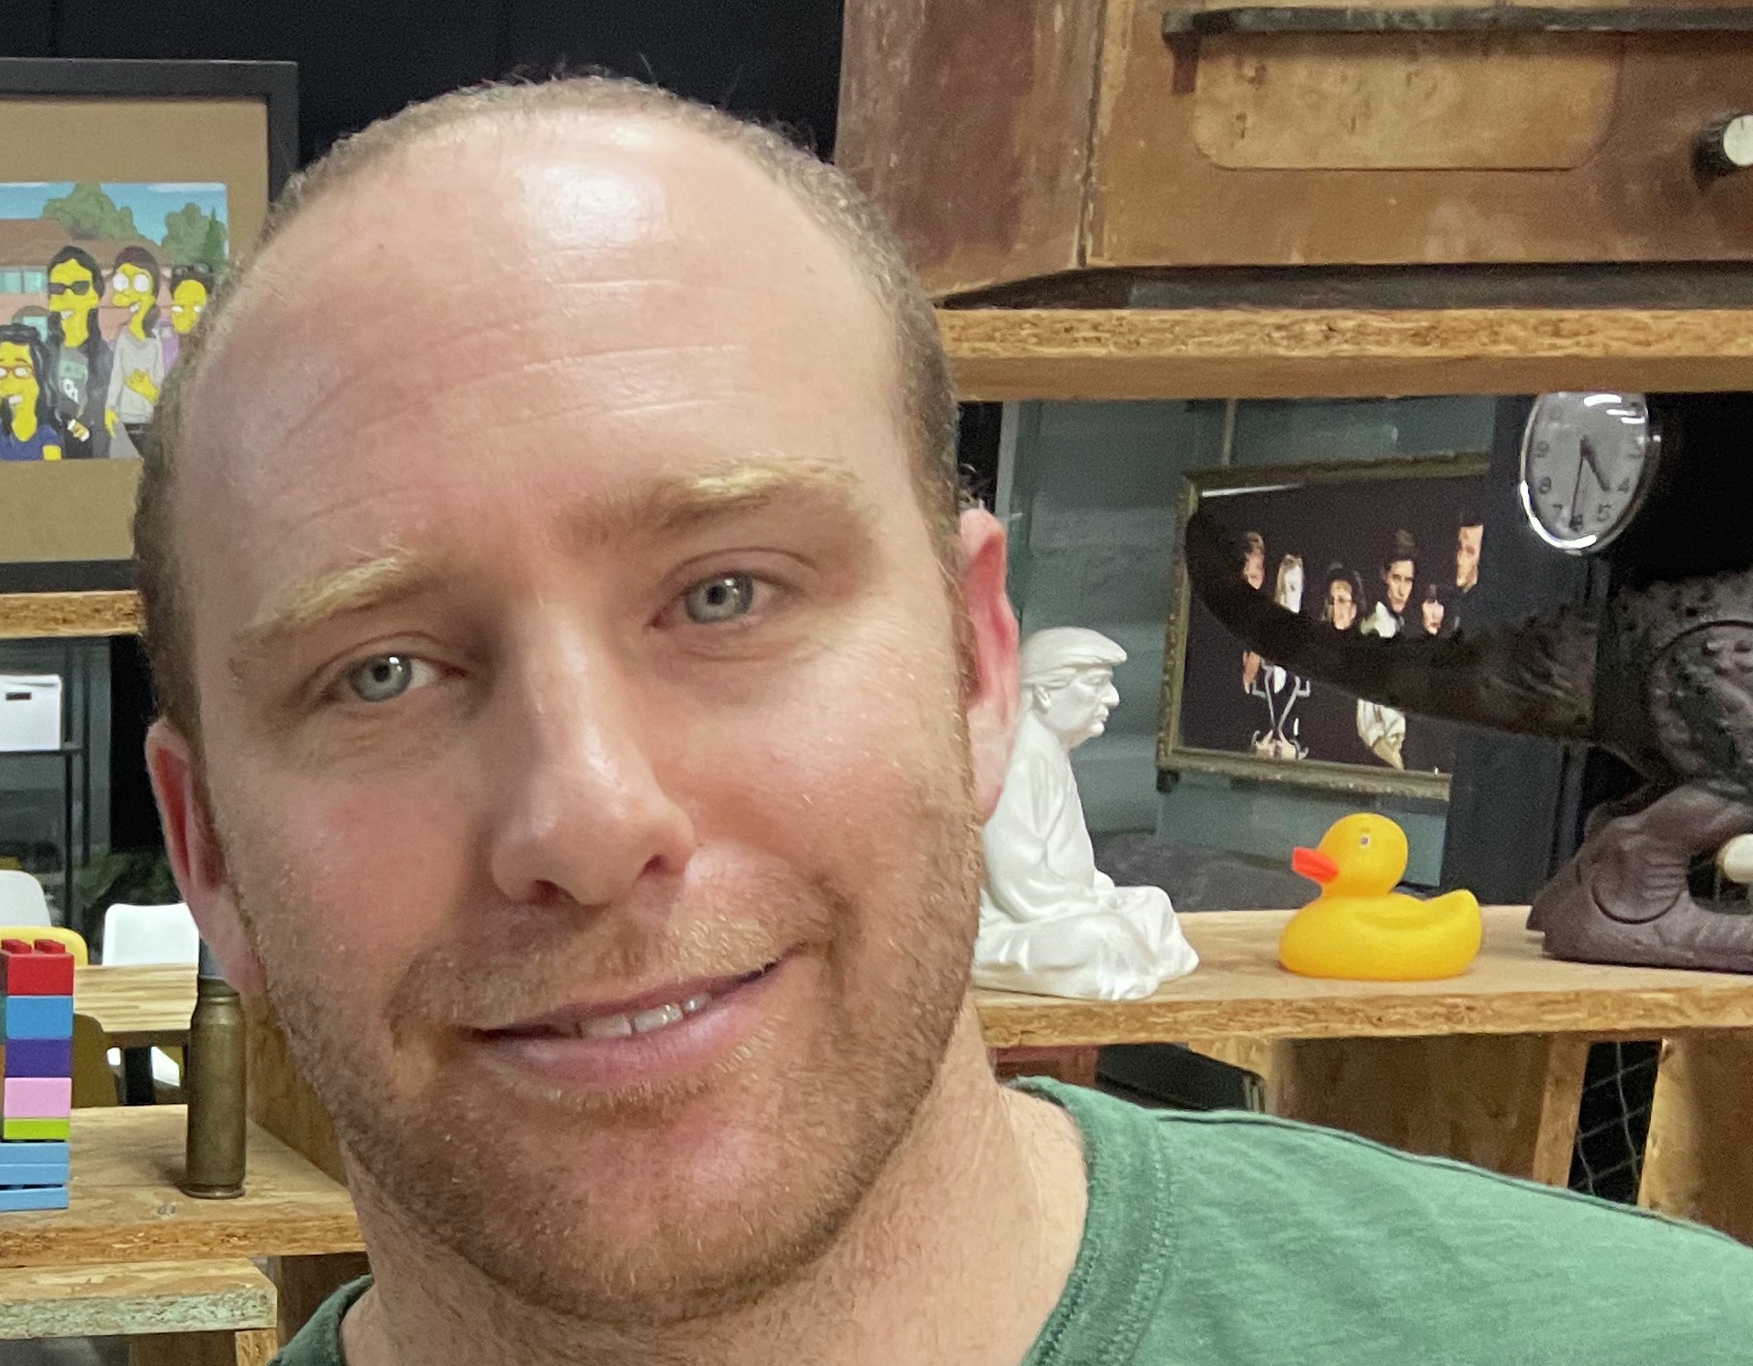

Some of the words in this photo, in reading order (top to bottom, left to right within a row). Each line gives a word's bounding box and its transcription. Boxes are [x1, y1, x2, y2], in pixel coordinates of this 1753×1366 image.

[1535, 440, 1550, 458] 9
[1539, 476, 1552, 494] 8
[1617, 477, 1630, 493] 4
[1552, 503, 1563, 521] 7
[1596, 502, 1612, 522] 5
